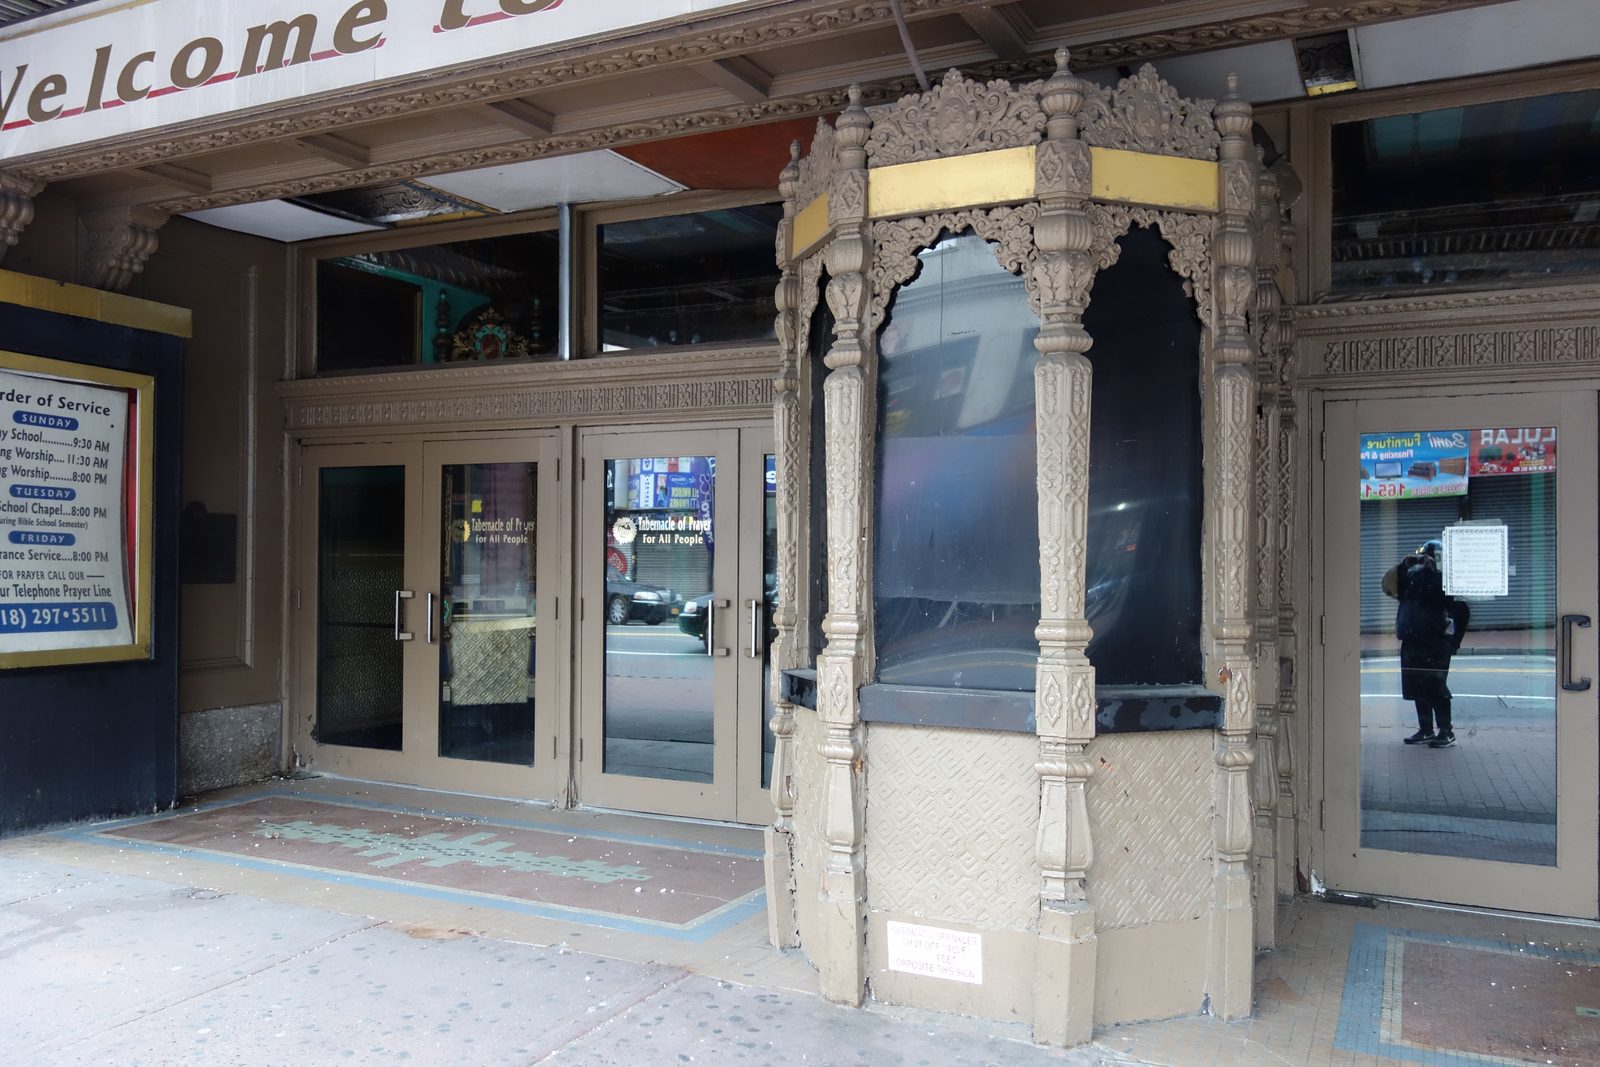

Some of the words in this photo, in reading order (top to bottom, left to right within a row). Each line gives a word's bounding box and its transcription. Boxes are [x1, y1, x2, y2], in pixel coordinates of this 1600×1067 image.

[37, 394, 53, 407] of
[58, 396, 111, 416] Service
[22, 413, 71, 428] SUNDAY
[11, 428, 42, 442] School
[73, 437, 92, 450] 9:30
[94, 440, 110, 453] AM
[15, 447, 54, 464] Worship
[67, 454, 91, 467] 11:30
[93, 457, 109, 469] AM
[11, 464, 50, 482] Worship
[72, 472, 91, 483] 8:00
[94, 473, 107, 485] PM
[16, 487, 71, 498] TUESDAY
[31, 503, 63, 517] Chapel
[71, 506, 91, 517] 8:00
[93, 507, 107, 518] PM
[18, 517, 34, 526] Bible
[36, 518, 57, 528] School
[471, 517, 504, 531] Tabernacle
[505, 517, 513, 531] of
[638, 516, 675, 530] Tabernacle
[677, 516, 687, 530] of
[688, 516, 711, 534] Prayer
[20, 533, 65, 543] FRIDAY
[489, 534, 500, 543] All
[503, 534, 529, 546] People
[642, 534, 656, 544] For
[658, 534, 671, 544] All
[674, 534, 703, 547] People
[28, 548, 61, 560] Service
[72, 551, 92, 562] 8:00
[95, 551, 109, 562] PM
[16, 570, 45, 580] PRAYER
[48, 571, 66, 580] CALL
[68, 571, 85, 580] OUR
[12, 584, 60, 600] Telephone
[63, 584, 91, 600] Prayer
[93, 584, 112, 597] Line
[895, 957, 935, 973] OPPOSITE
[937, 964, 954, 976] THIS
